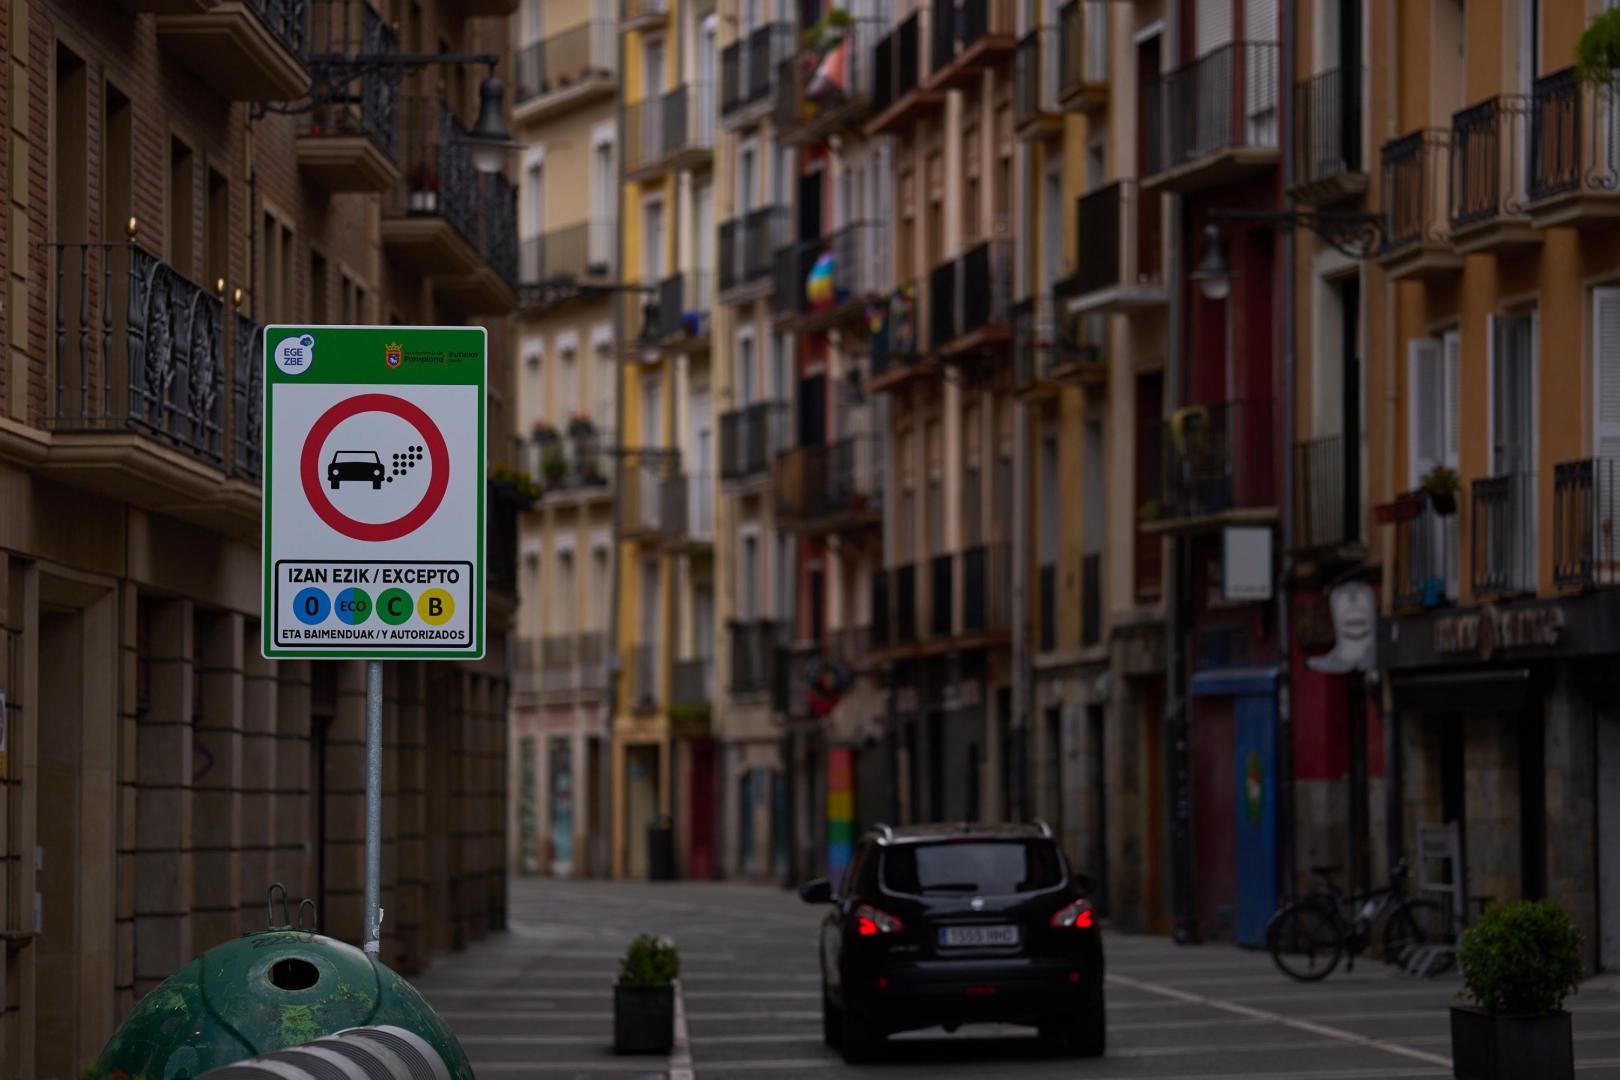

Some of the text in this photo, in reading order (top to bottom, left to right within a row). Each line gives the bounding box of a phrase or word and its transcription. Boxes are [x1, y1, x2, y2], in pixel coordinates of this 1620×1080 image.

[284, 348, 303, 357] EGE
[284, 357, 303, 366] ZBE
[288, 568, 328, 583] IZAN
[333, 568, 370, 584] EZIK
[382, 569, 460, 584] EXCEPTO
[305, 596, 442, 616] 0 ECO C B
[282, 630, 301, 639] ETA
[304, 630, 374, 640] BAIMENDUAK
[382, 630, 388, 639] Y
[390, 630, 464, 640] AUTORIZADOS
